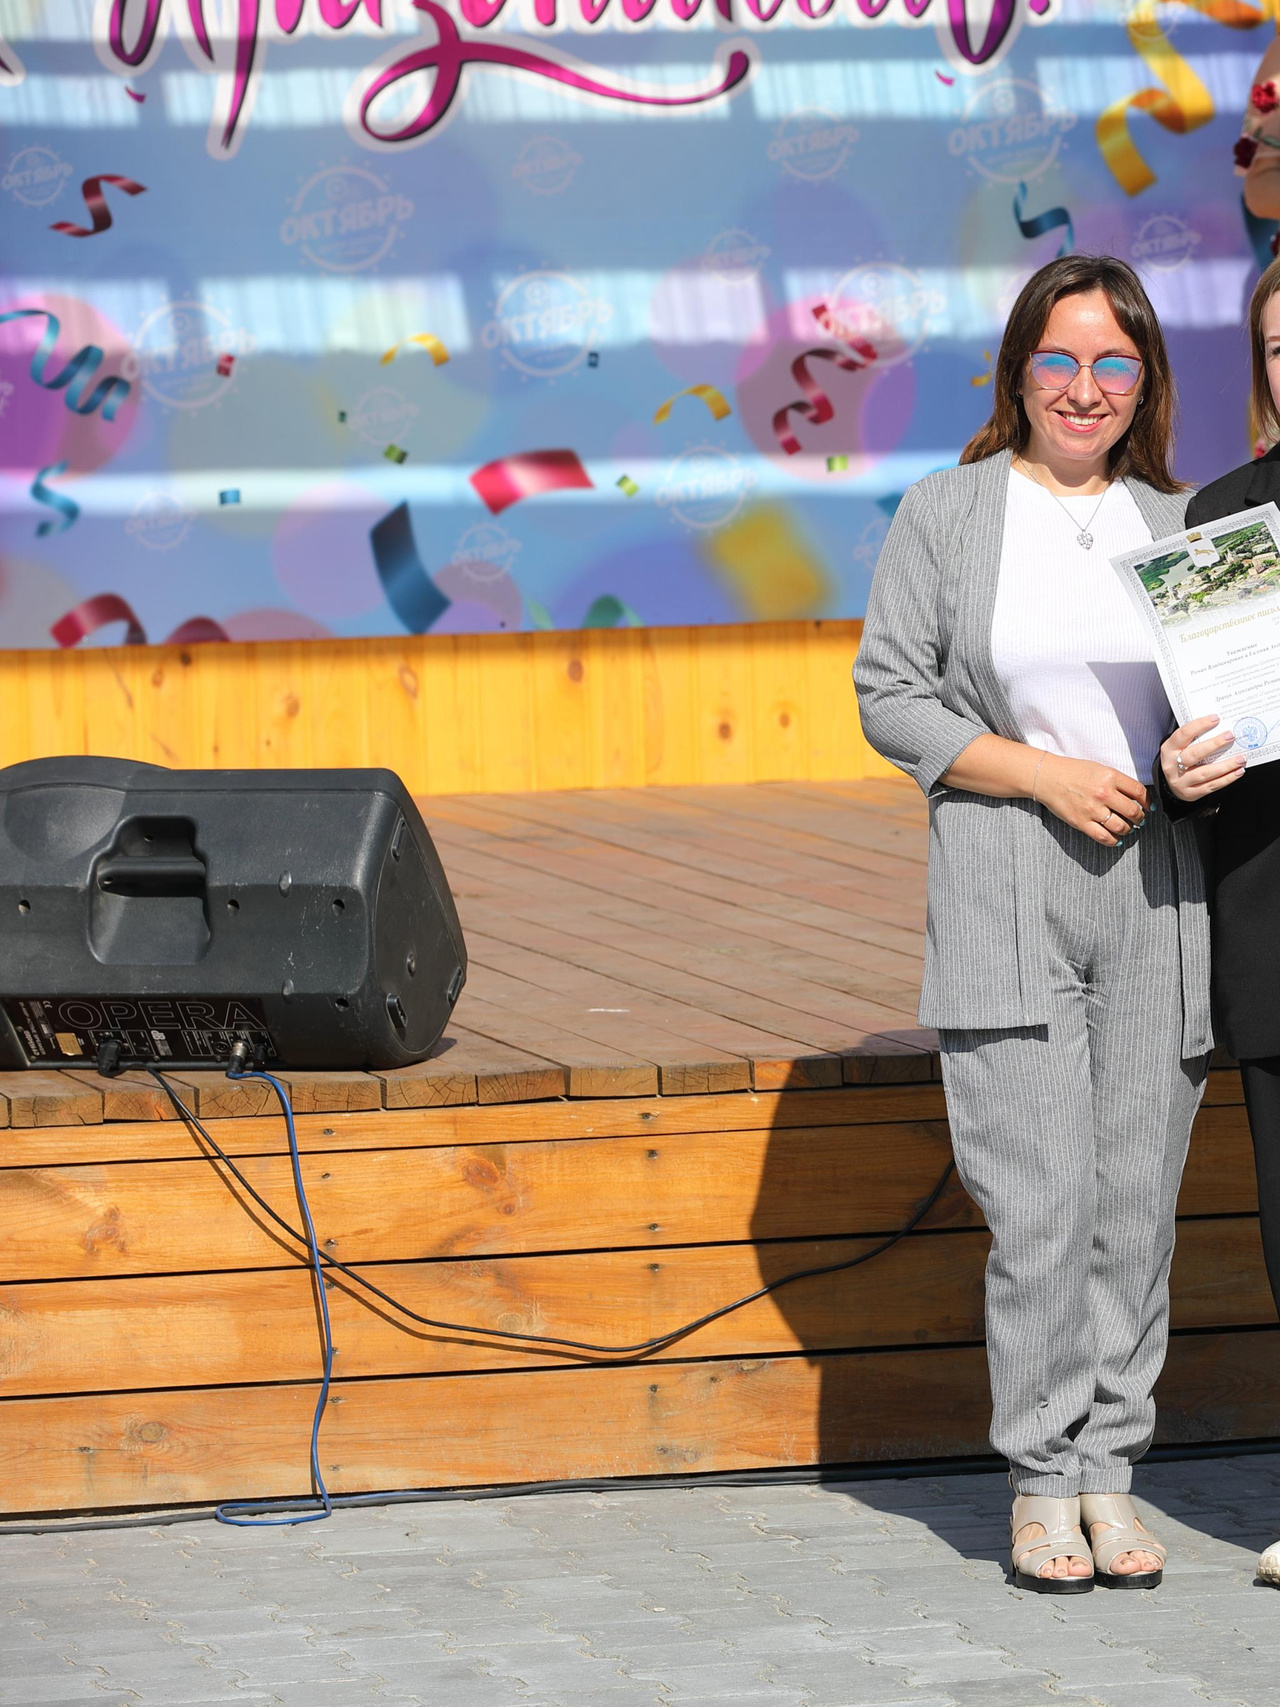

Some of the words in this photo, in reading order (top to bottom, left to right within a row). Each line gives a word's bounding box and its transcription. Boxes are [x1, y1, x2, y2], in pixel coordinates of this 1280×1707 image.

[768, 126, 861, 163] ОКТЯБРЬ
[947, 105, 1077, 156] ОКТЯБРЬ
[1, 159, 73, 190] ОКТЯБРЬ
[279, 194, 415, 246] ОКТЯБРЬ
[1131, 230, 1202, 257] ОКТЯБРЬ
[481, 301, 613, 349] ОКТЯБРЬ
[122, 327, 255, 377] ОКТЯБРЬ
[656, 468, 758, 506] ОКТЯБРЬ
[451, 537, 523, 565] ОКТЯБРЬ
[1179, 612, 1257, 644] Благодарственное
[58, 1001, 267, 1029] OPERA
